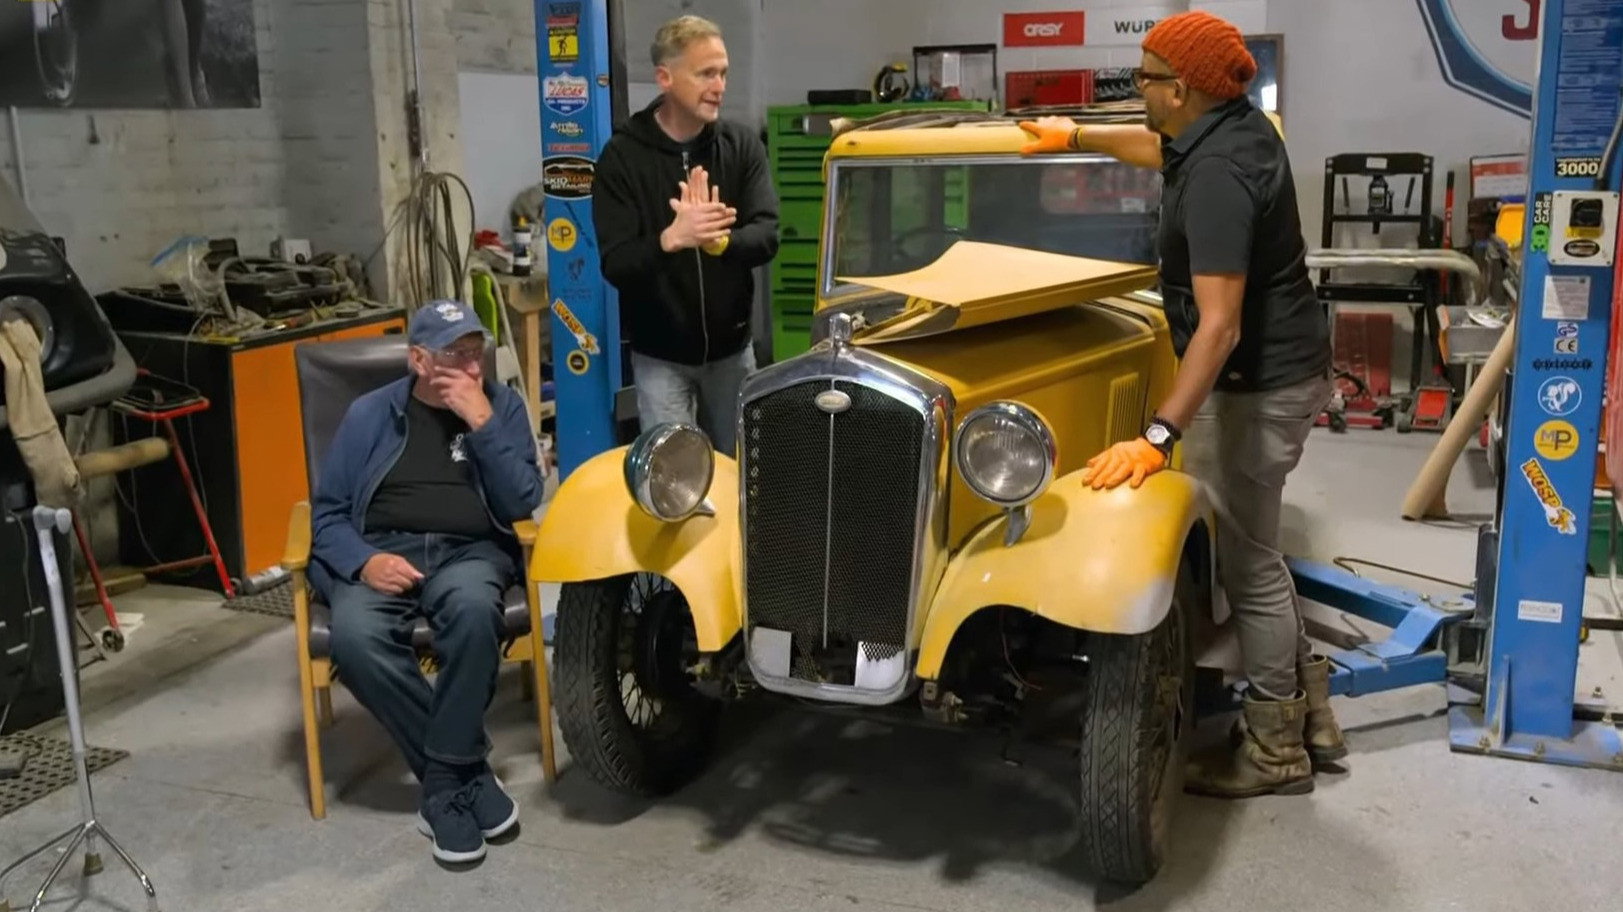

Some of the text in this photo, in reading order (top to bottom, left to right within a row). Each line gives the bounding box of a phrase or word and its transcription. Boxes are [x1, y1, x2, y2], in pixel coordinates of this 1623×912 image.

[548, 85, 585, 97] LUCAS
[1557, 162, 1599, 176] 3000
[1534, 200, 1543, 223] CAR
[1542, 193, 1552, 224] CARE
[1541, 429, 1572, 450] MP
[1522, 459, 1562, 509] WOSP
